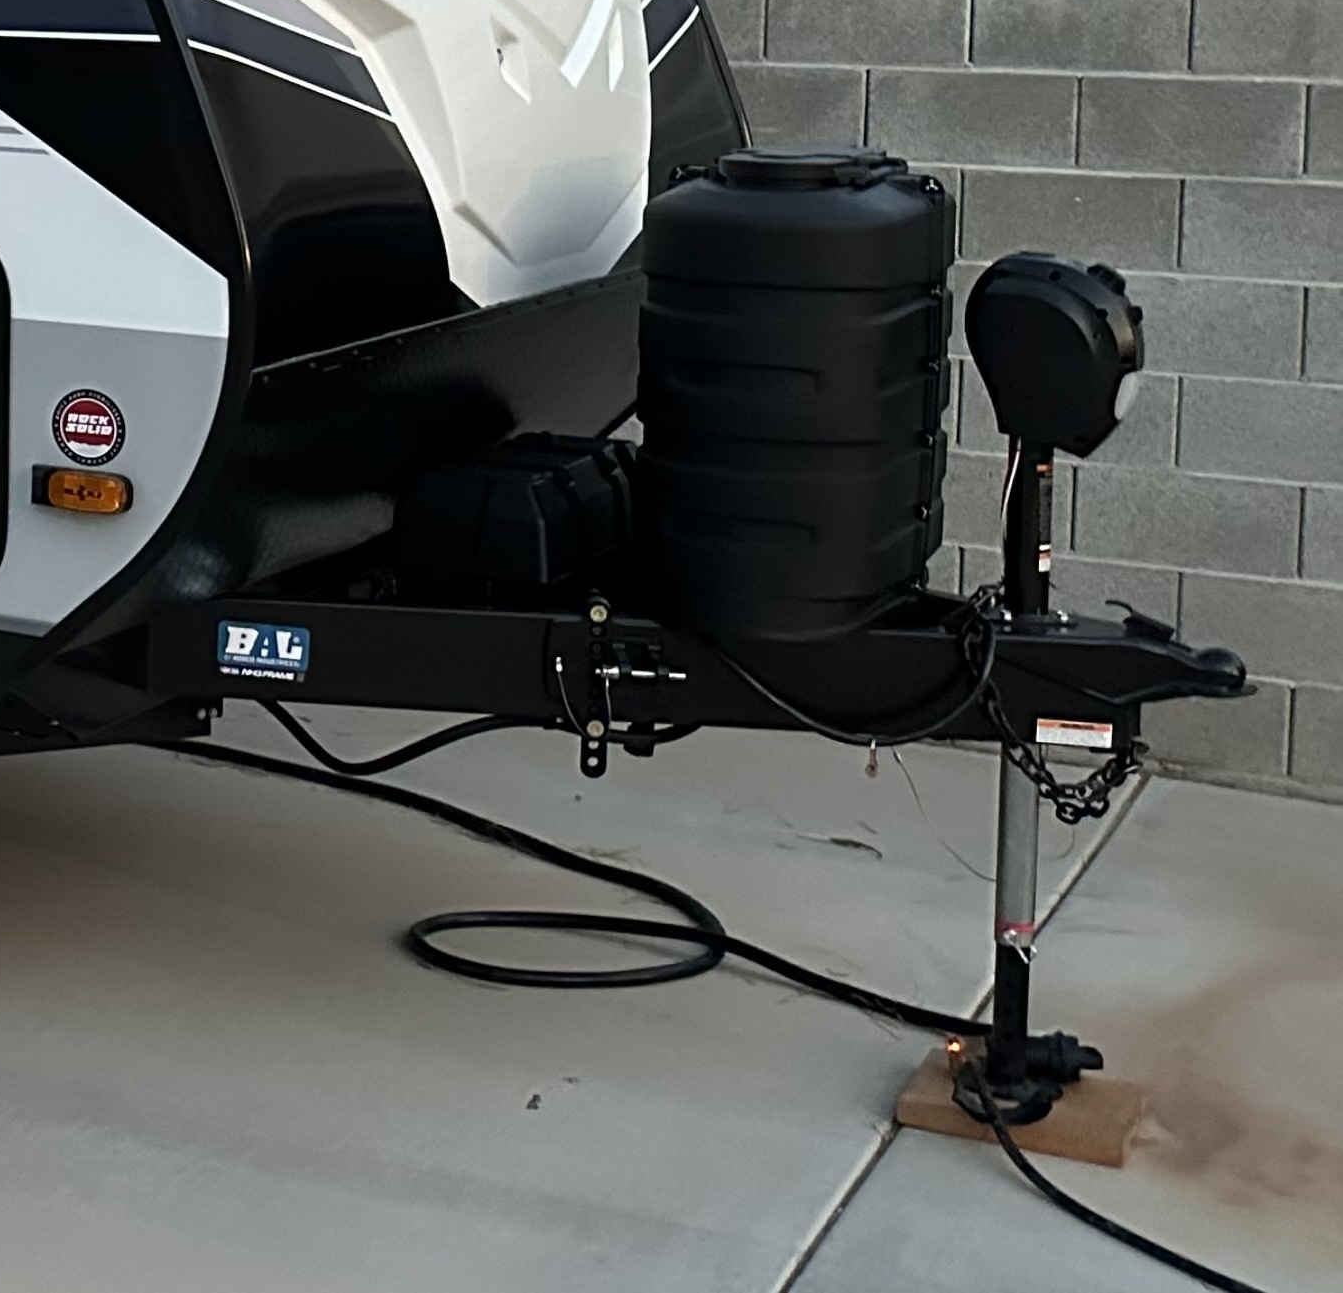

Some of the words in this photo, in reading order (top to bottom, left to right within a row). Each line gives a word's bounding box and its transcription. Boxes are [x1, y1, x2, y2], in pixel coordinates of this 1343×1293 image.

[67, 413, 110, 425] ROCK
[65, 423, 113, 435] SOLID
[225, 625, 303, 660] BAL
